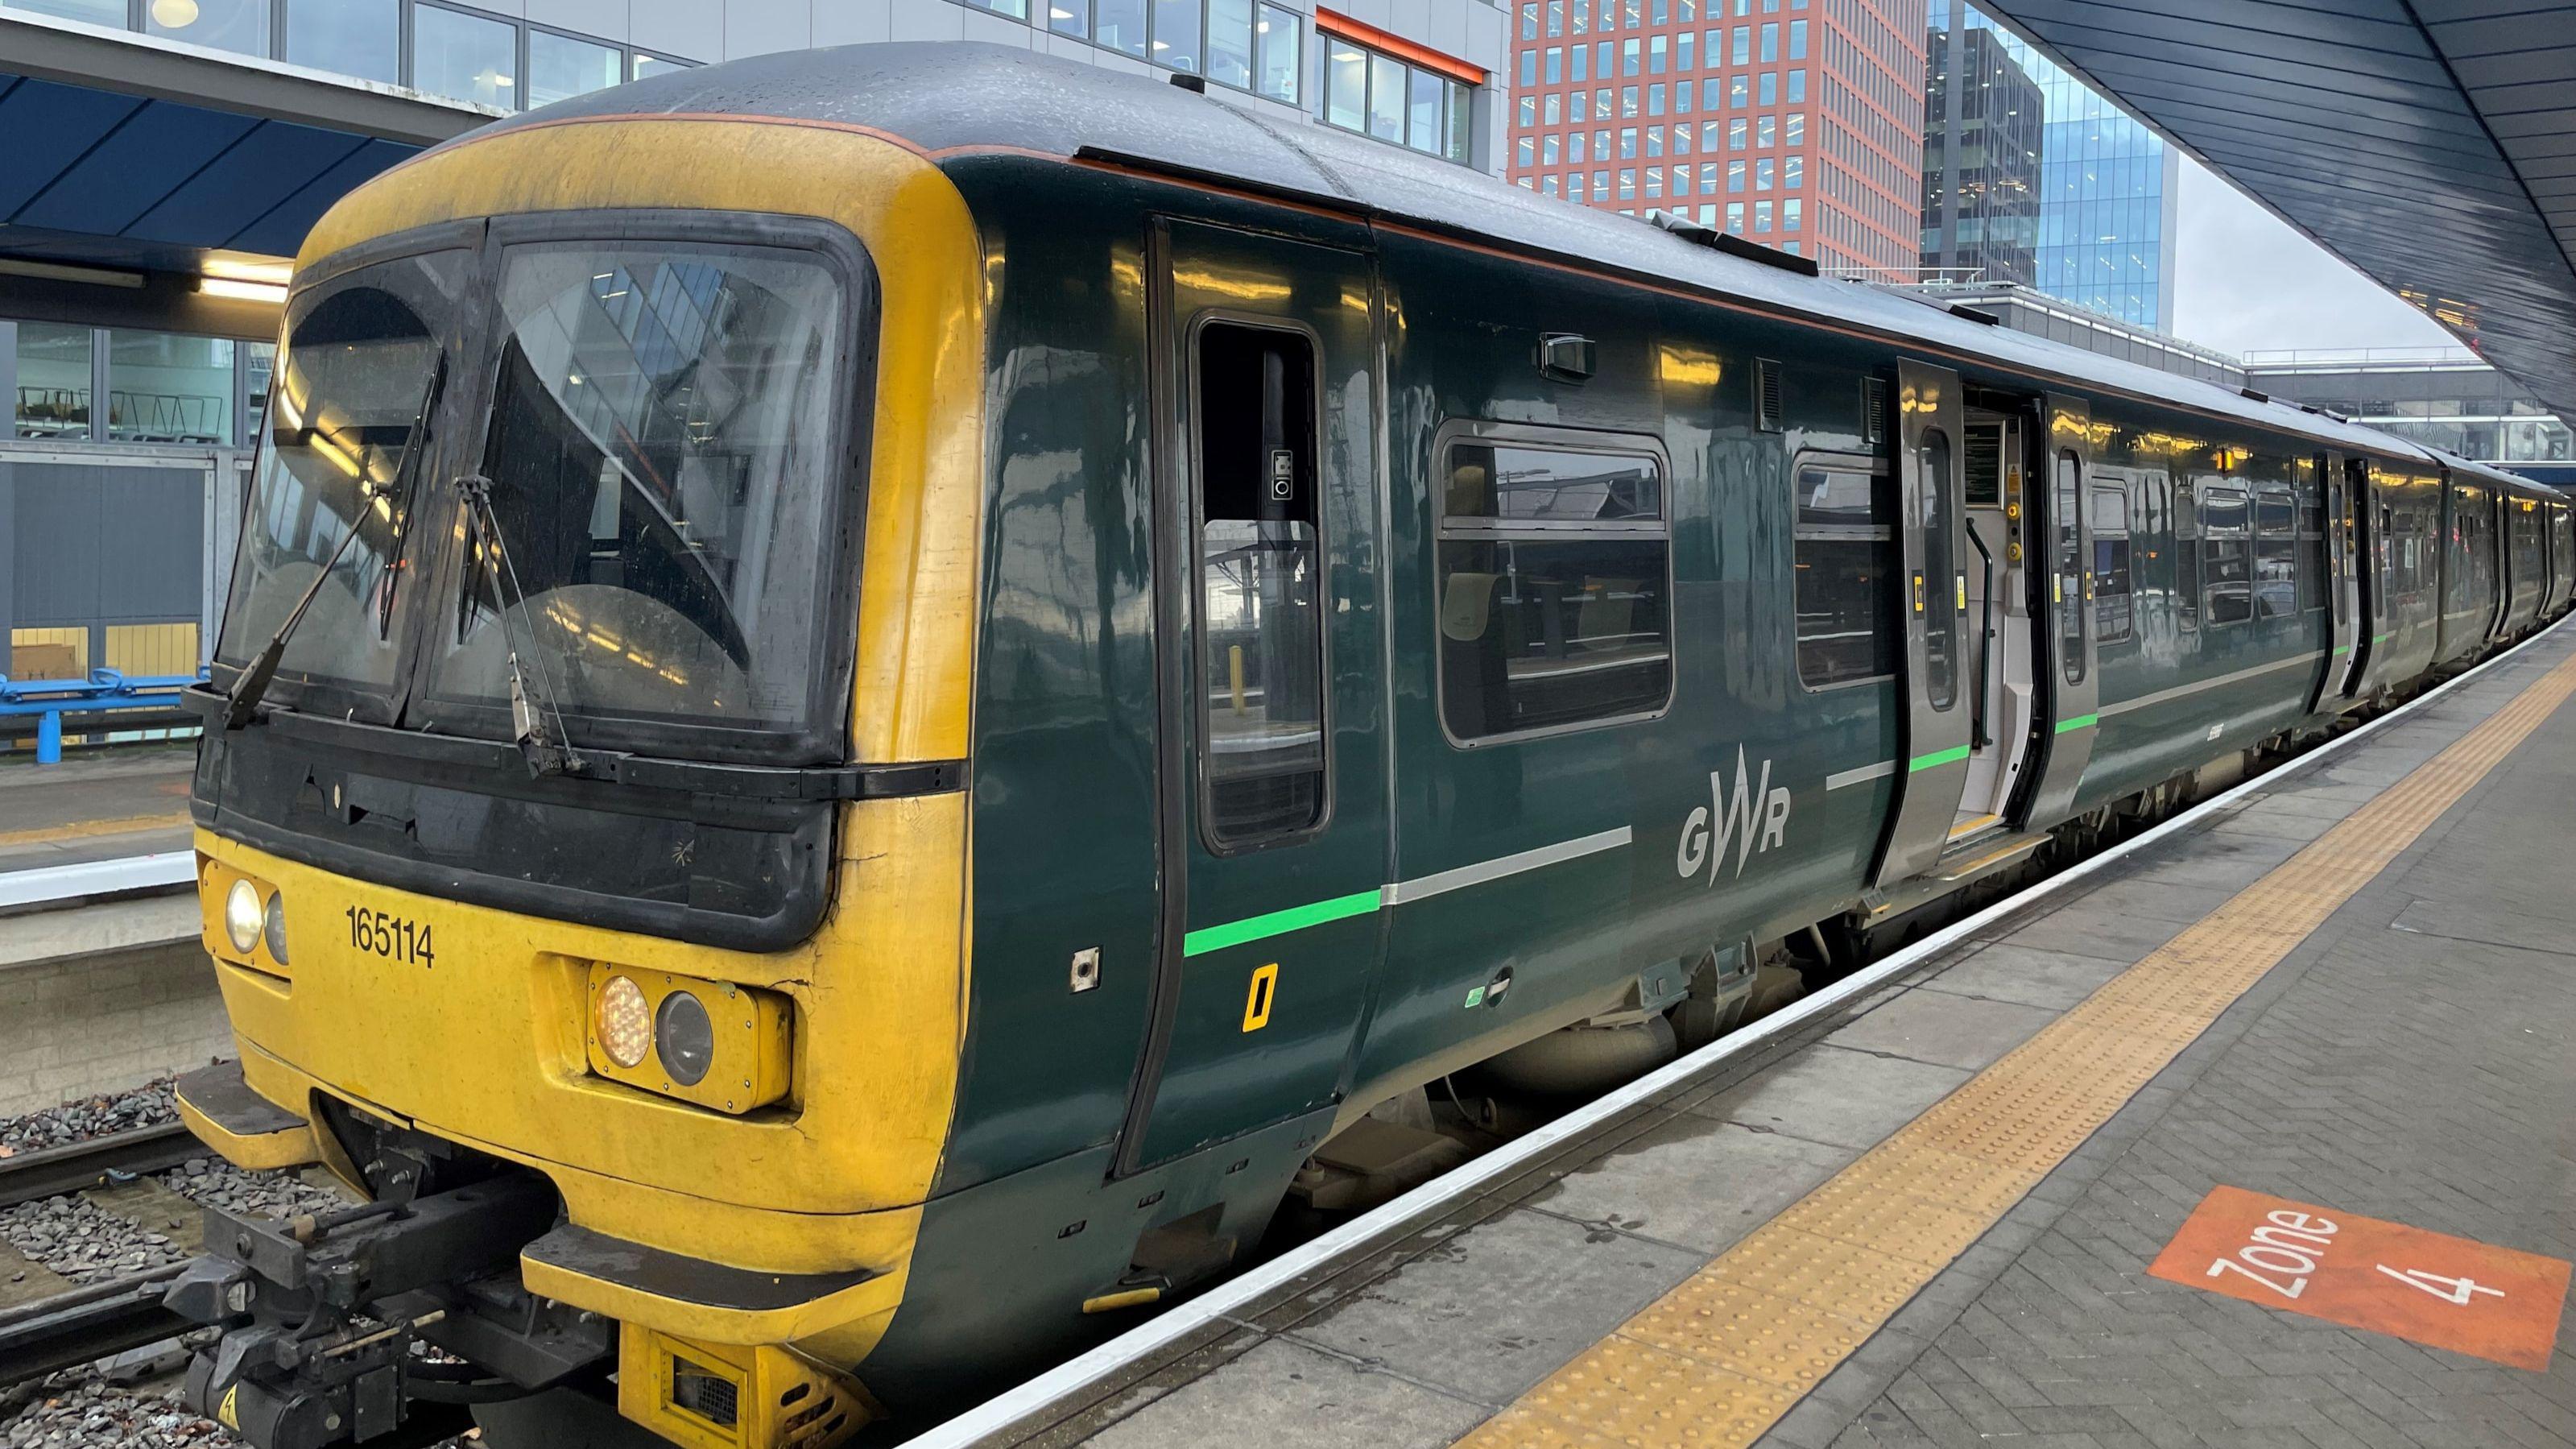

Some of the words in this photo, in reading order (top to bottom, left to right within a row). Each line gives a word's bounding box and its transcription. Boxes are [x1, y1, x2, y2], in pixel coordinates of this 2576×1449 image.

[1677, 742, 1791, 888] GWR
[346, 905, 434, 968] 165114
[2206, 1210, 2338, 1299] Zone
[2375, 1264, 2505, 1306] 4
